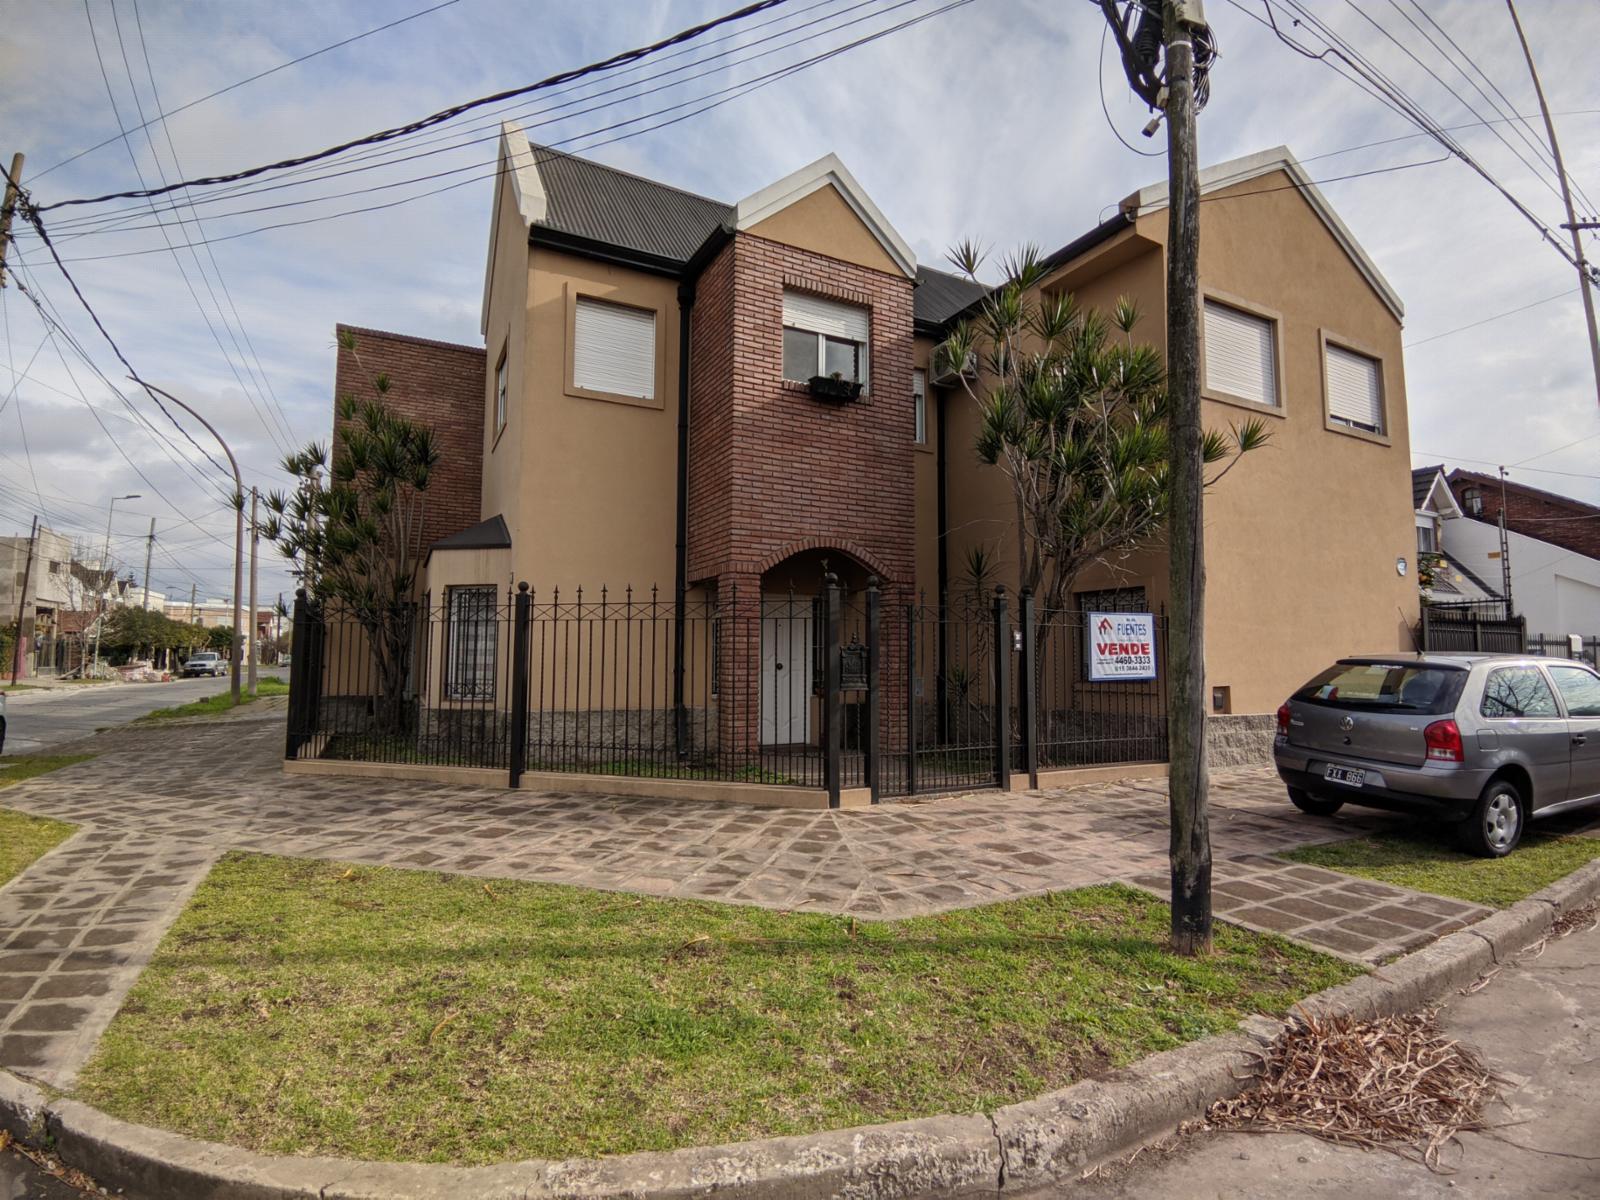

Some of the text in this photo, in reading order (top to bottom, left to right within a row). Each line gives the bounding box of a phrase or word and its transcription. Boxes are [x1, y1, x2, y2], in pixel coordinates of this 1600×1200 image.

[1117, 624, 1146, 635] FUENTES
[1097, 643, 1150, 655] VENDE
[1115, 656, 1150, 664] 4460-3333
